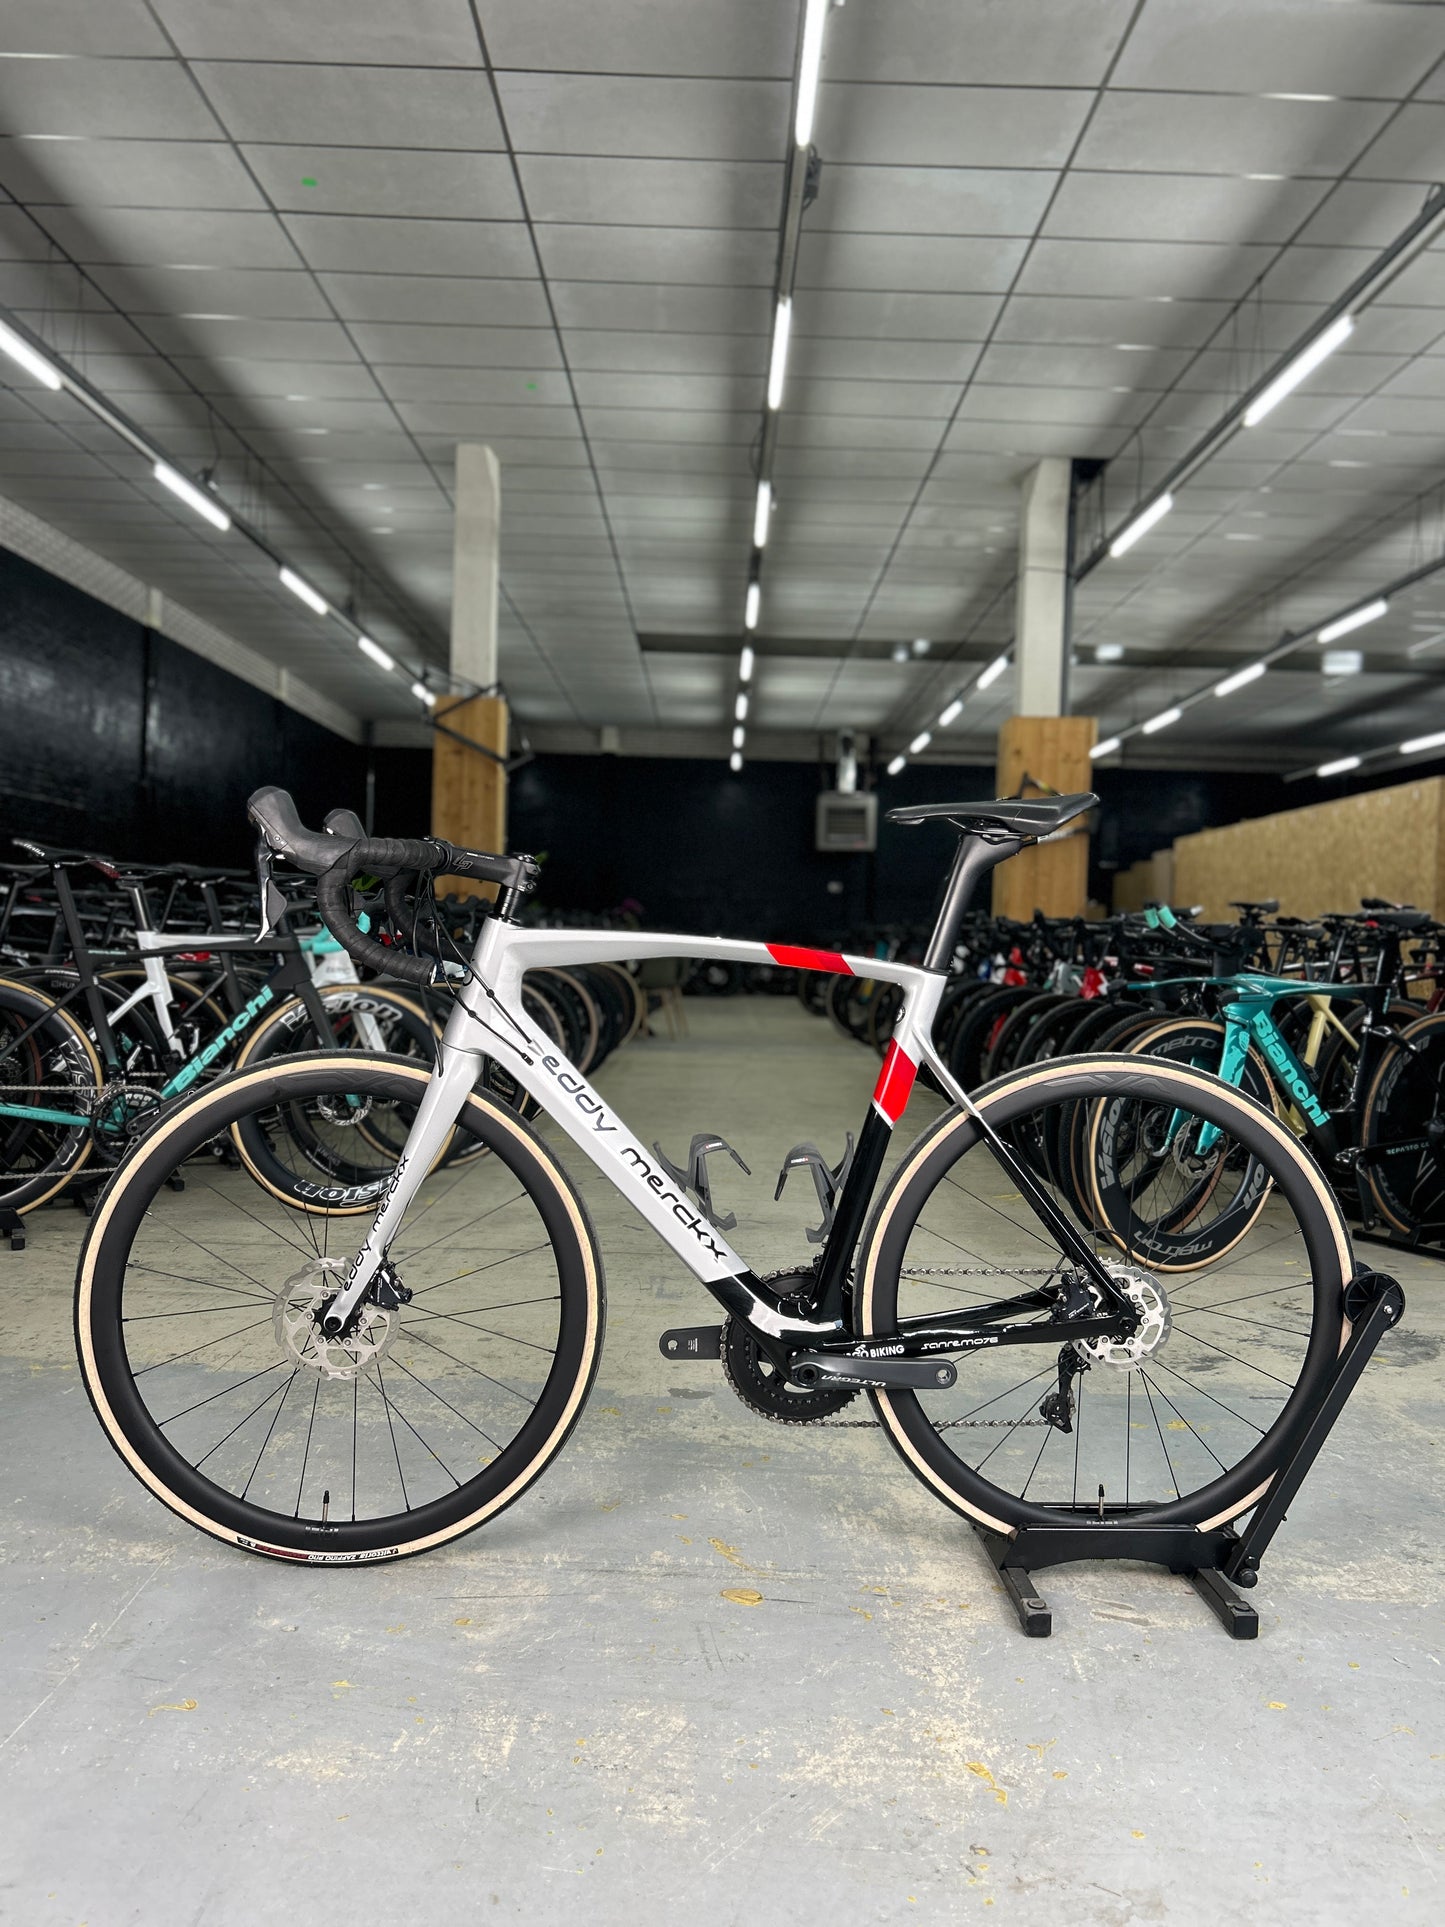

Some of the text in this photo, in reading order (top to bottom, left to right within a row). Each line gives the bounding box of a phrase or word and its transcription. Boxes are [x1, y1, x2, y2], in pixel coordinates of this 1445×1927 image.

[172, 985, 274, 1092] Bianchi
[1150, 1035, 1218, 1056] metro
[1252, 1010, 1330, 1128] Bianchi
[542, 1055, 728, 1260] eddy merckx
[1098, 1097, 1126, 1189] Visio
[343, 1238, 371, 1291] eddy
[372, 1156, 409, 1232] merckx
[1133, 1230, 1213, 1256] metron
[870, 1344, 905, 1358] BIKING
[920, 1336, 999, 1350] sanremo76
[821, 1374, 887, 1387] ULTEGRA
